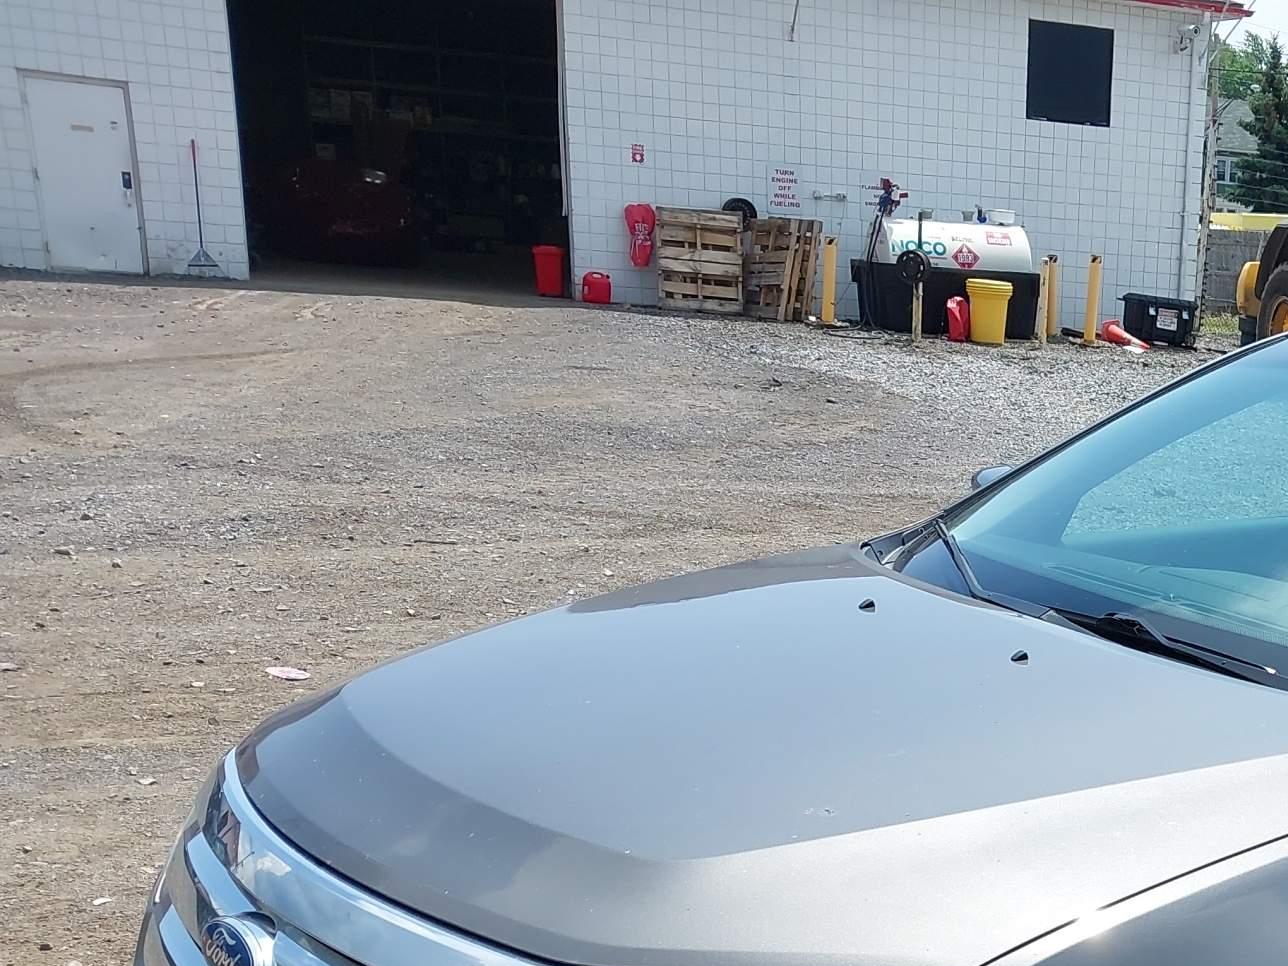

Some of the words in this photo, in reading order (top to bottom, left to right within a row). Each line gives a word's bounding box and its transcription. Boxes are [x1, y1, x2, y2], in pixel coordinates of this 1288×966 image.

[774, 168, 795, 176] TURN
[771, 176, 799, 184] ENGINE
[770, 200, 801, 208] FUELING
[891, 240, 946, 256] NOCO
